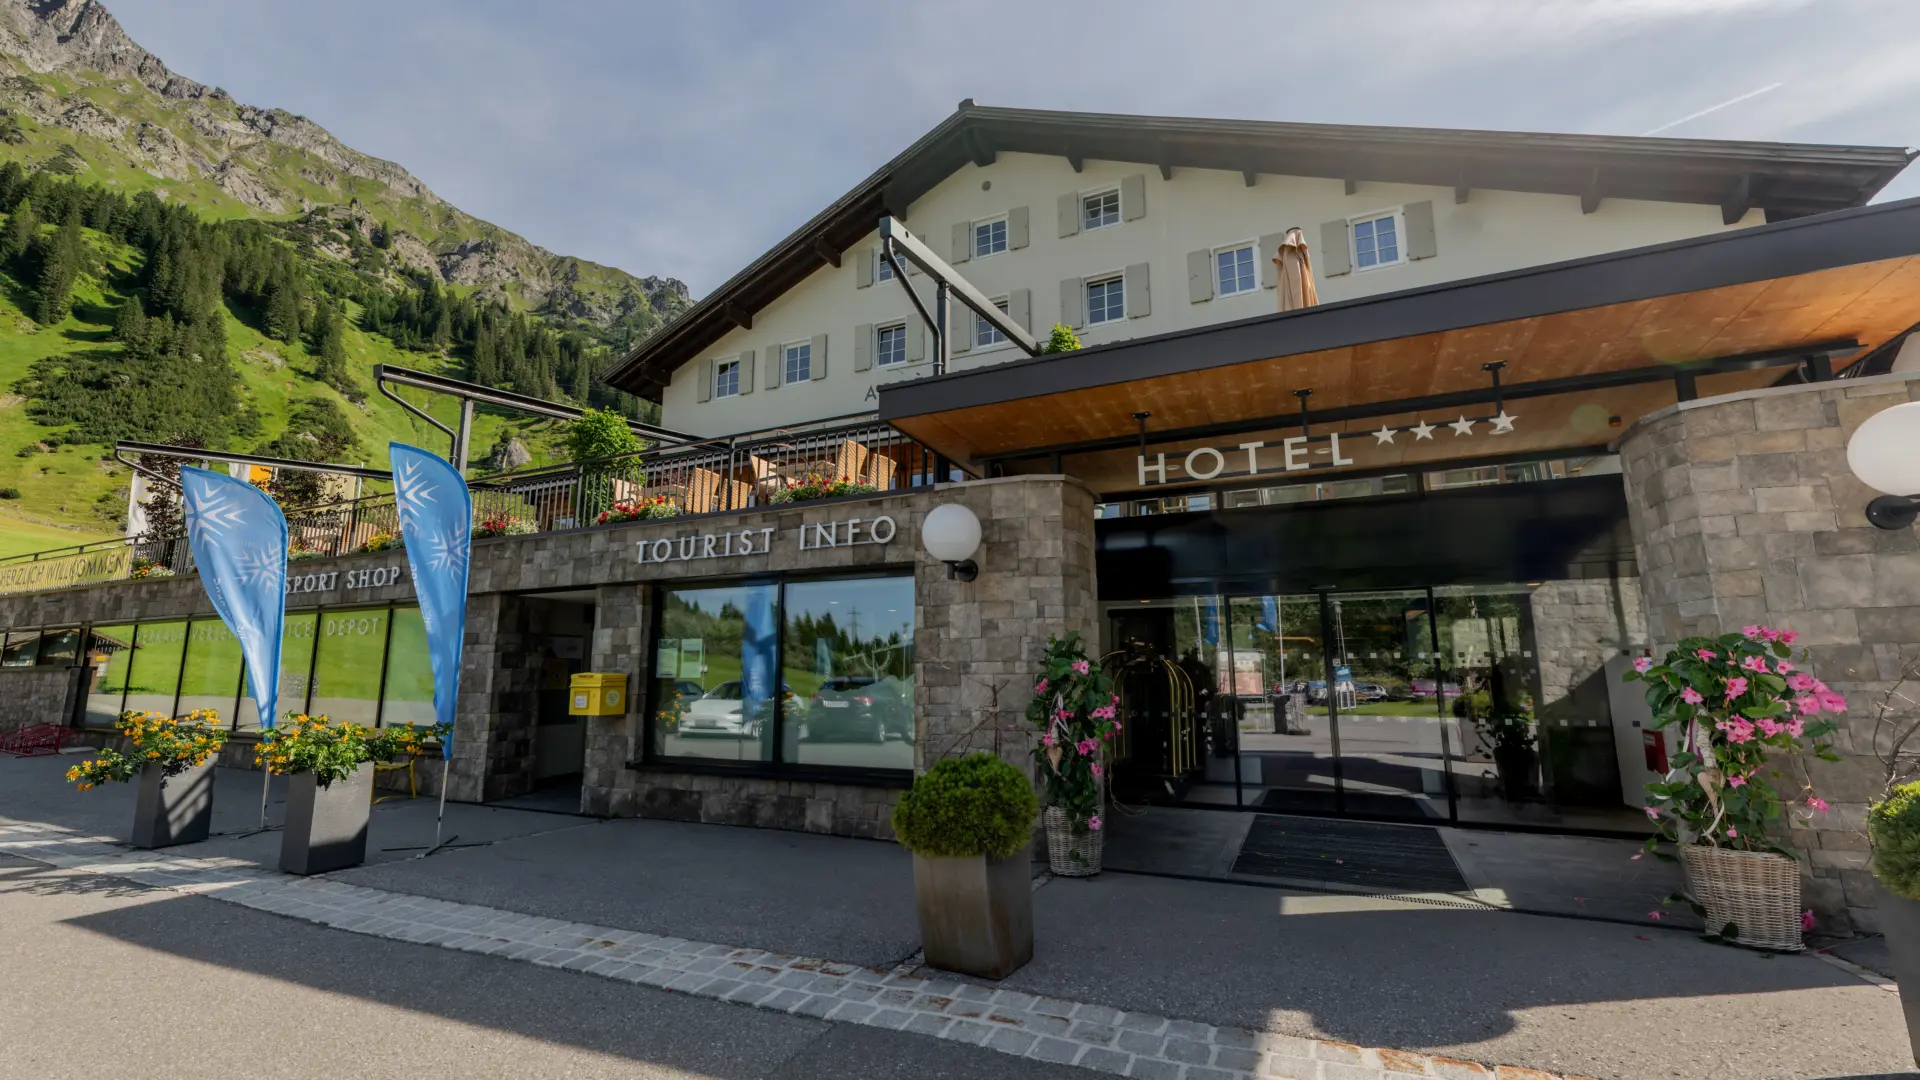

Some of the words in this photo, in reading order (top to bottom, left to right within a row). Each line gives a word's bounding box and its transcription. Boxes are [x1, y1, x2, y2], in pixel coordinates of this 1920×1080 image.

[1137, 432, 1354, 486] HOTEL
[636, 527, 775, 564] TOURIST
[800, 515, 896, 550] INFO
[47, 552, 126, 581] WILLKOMMEN
[285, 572, 339, 595] SPORT
[346, 566, 401, 590] SHOP
[326, 617, 379, 637] DEPOT
